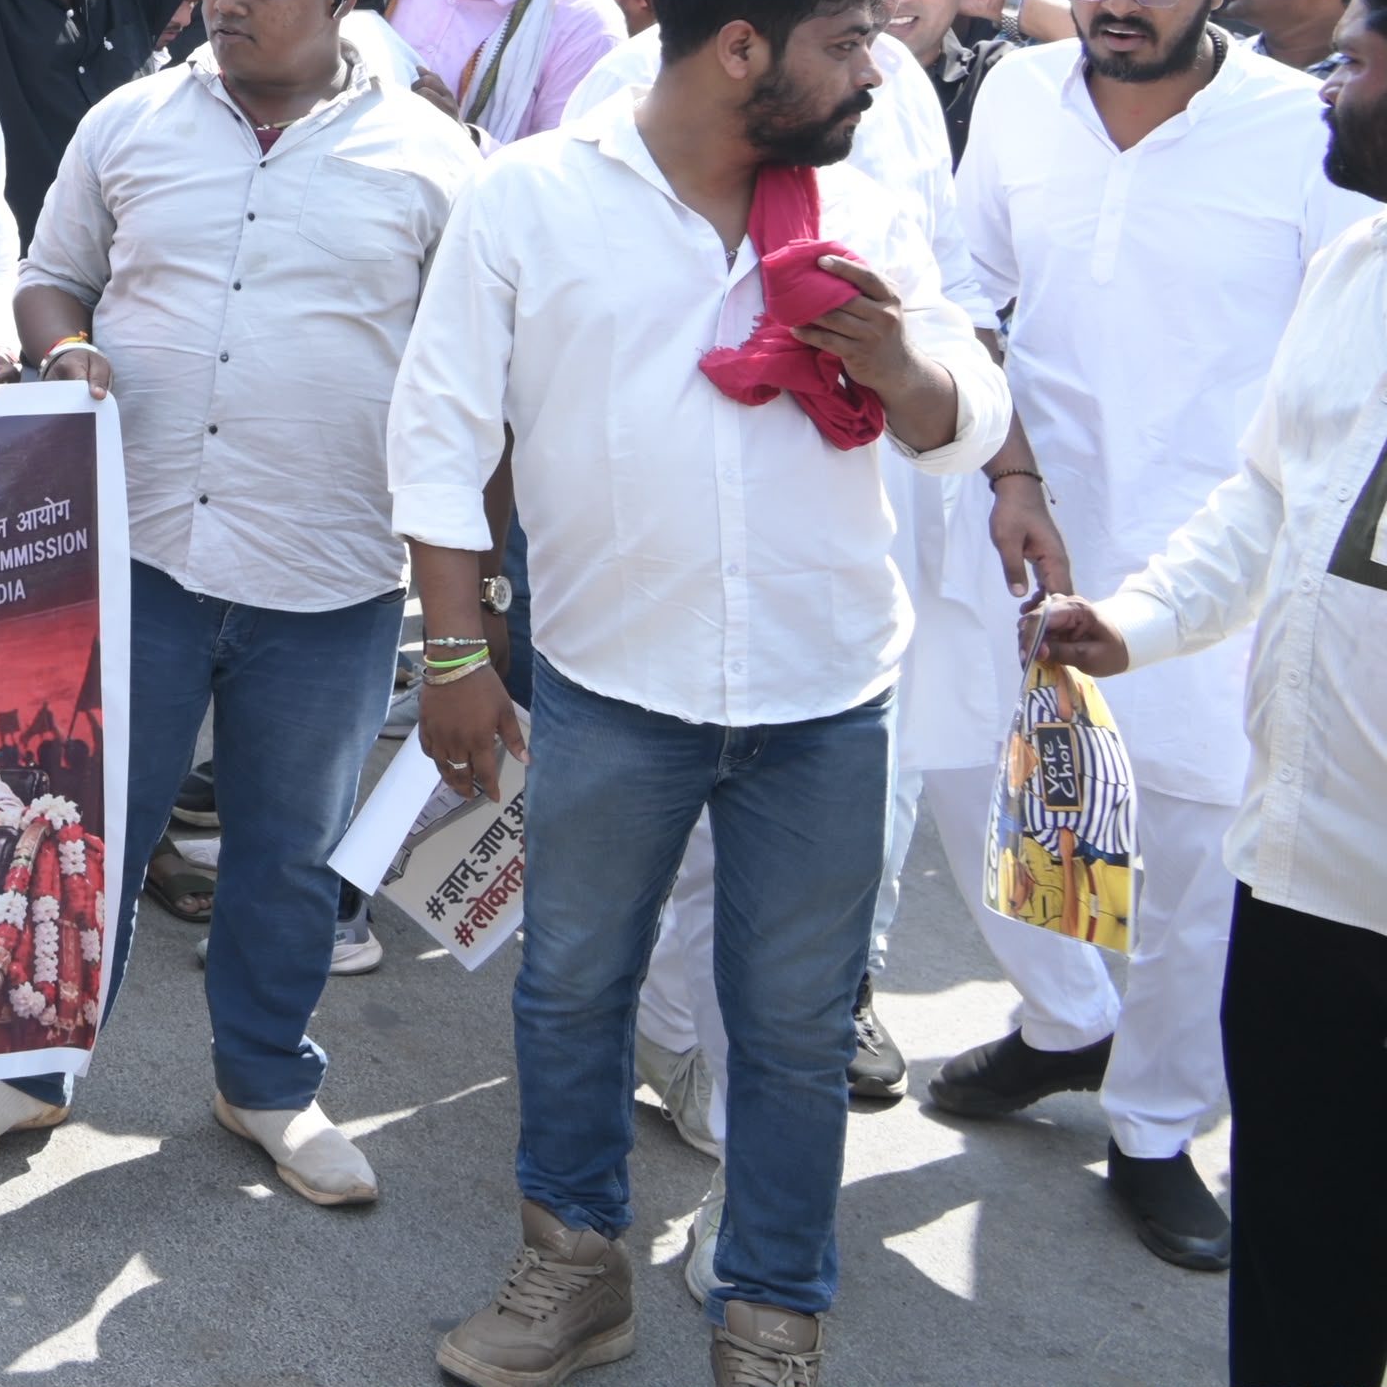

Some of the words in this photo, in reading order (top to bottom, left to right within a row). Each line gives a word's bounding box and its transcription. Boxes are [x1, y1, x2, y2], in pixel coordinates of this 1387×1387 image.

[16, 497, 70, 533] आयोग
[1045, 740, 1060, 795] Vote
[1060, 735, 1076, 798] Chor
